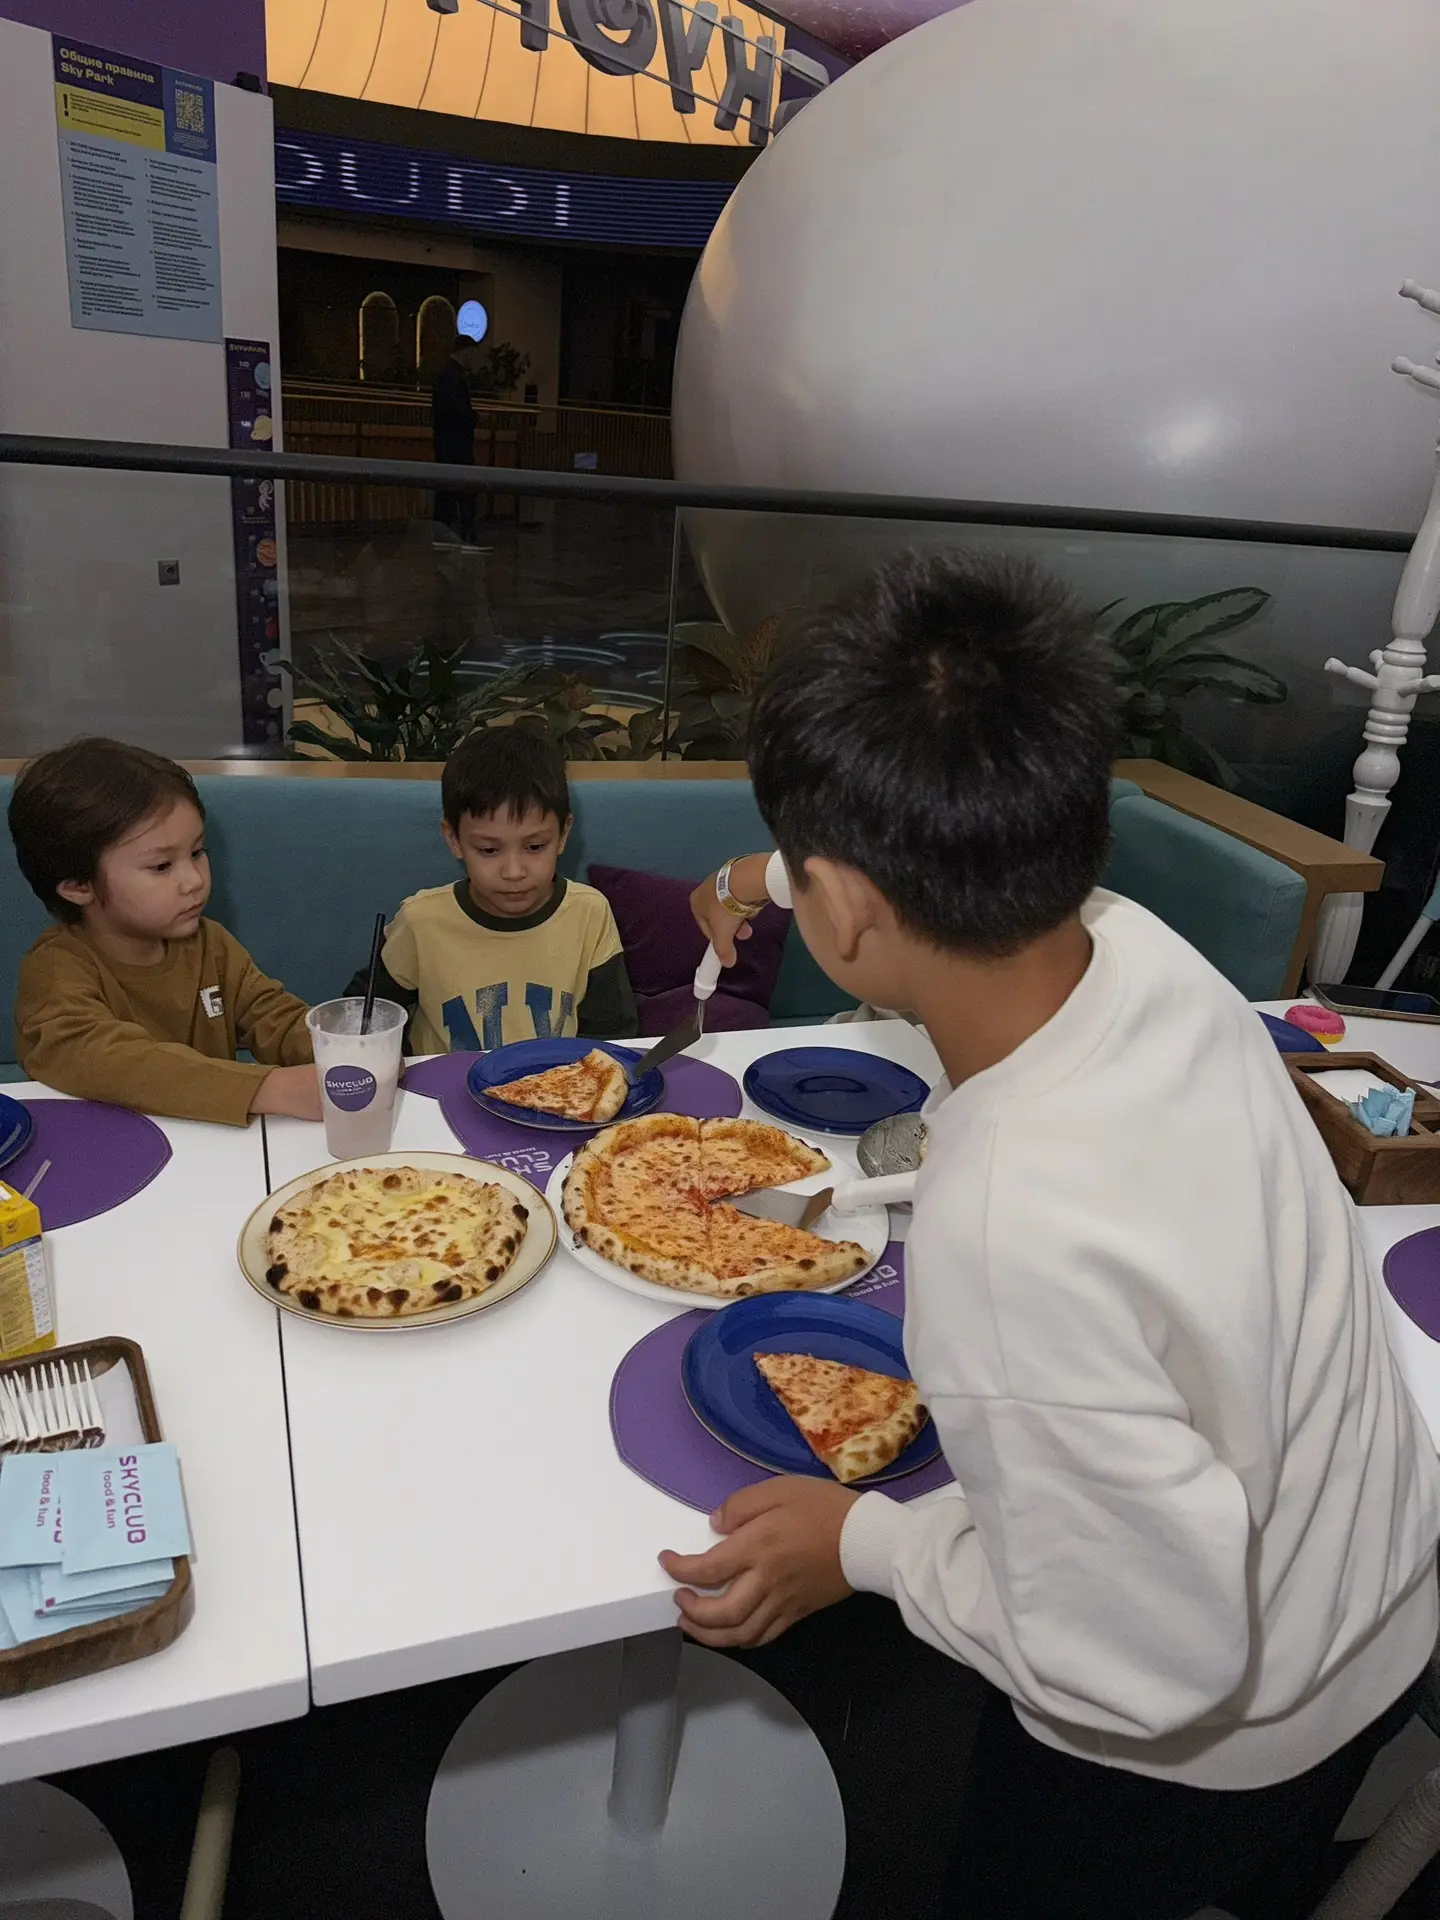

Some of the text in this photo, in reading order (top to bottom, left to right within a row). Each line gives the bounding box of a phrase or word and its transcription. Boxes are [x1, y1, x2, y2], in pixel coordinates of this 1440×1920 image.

[60, 47, 155, 83] Общие правила
[61, 62, 114, 85] Sky Park
[41, 1469, 54, 1495] food
[102, 1469, 115, 1497] food
[36, 1507, 49, 1528] fun
[106, 1508, 117, 1529] fun
